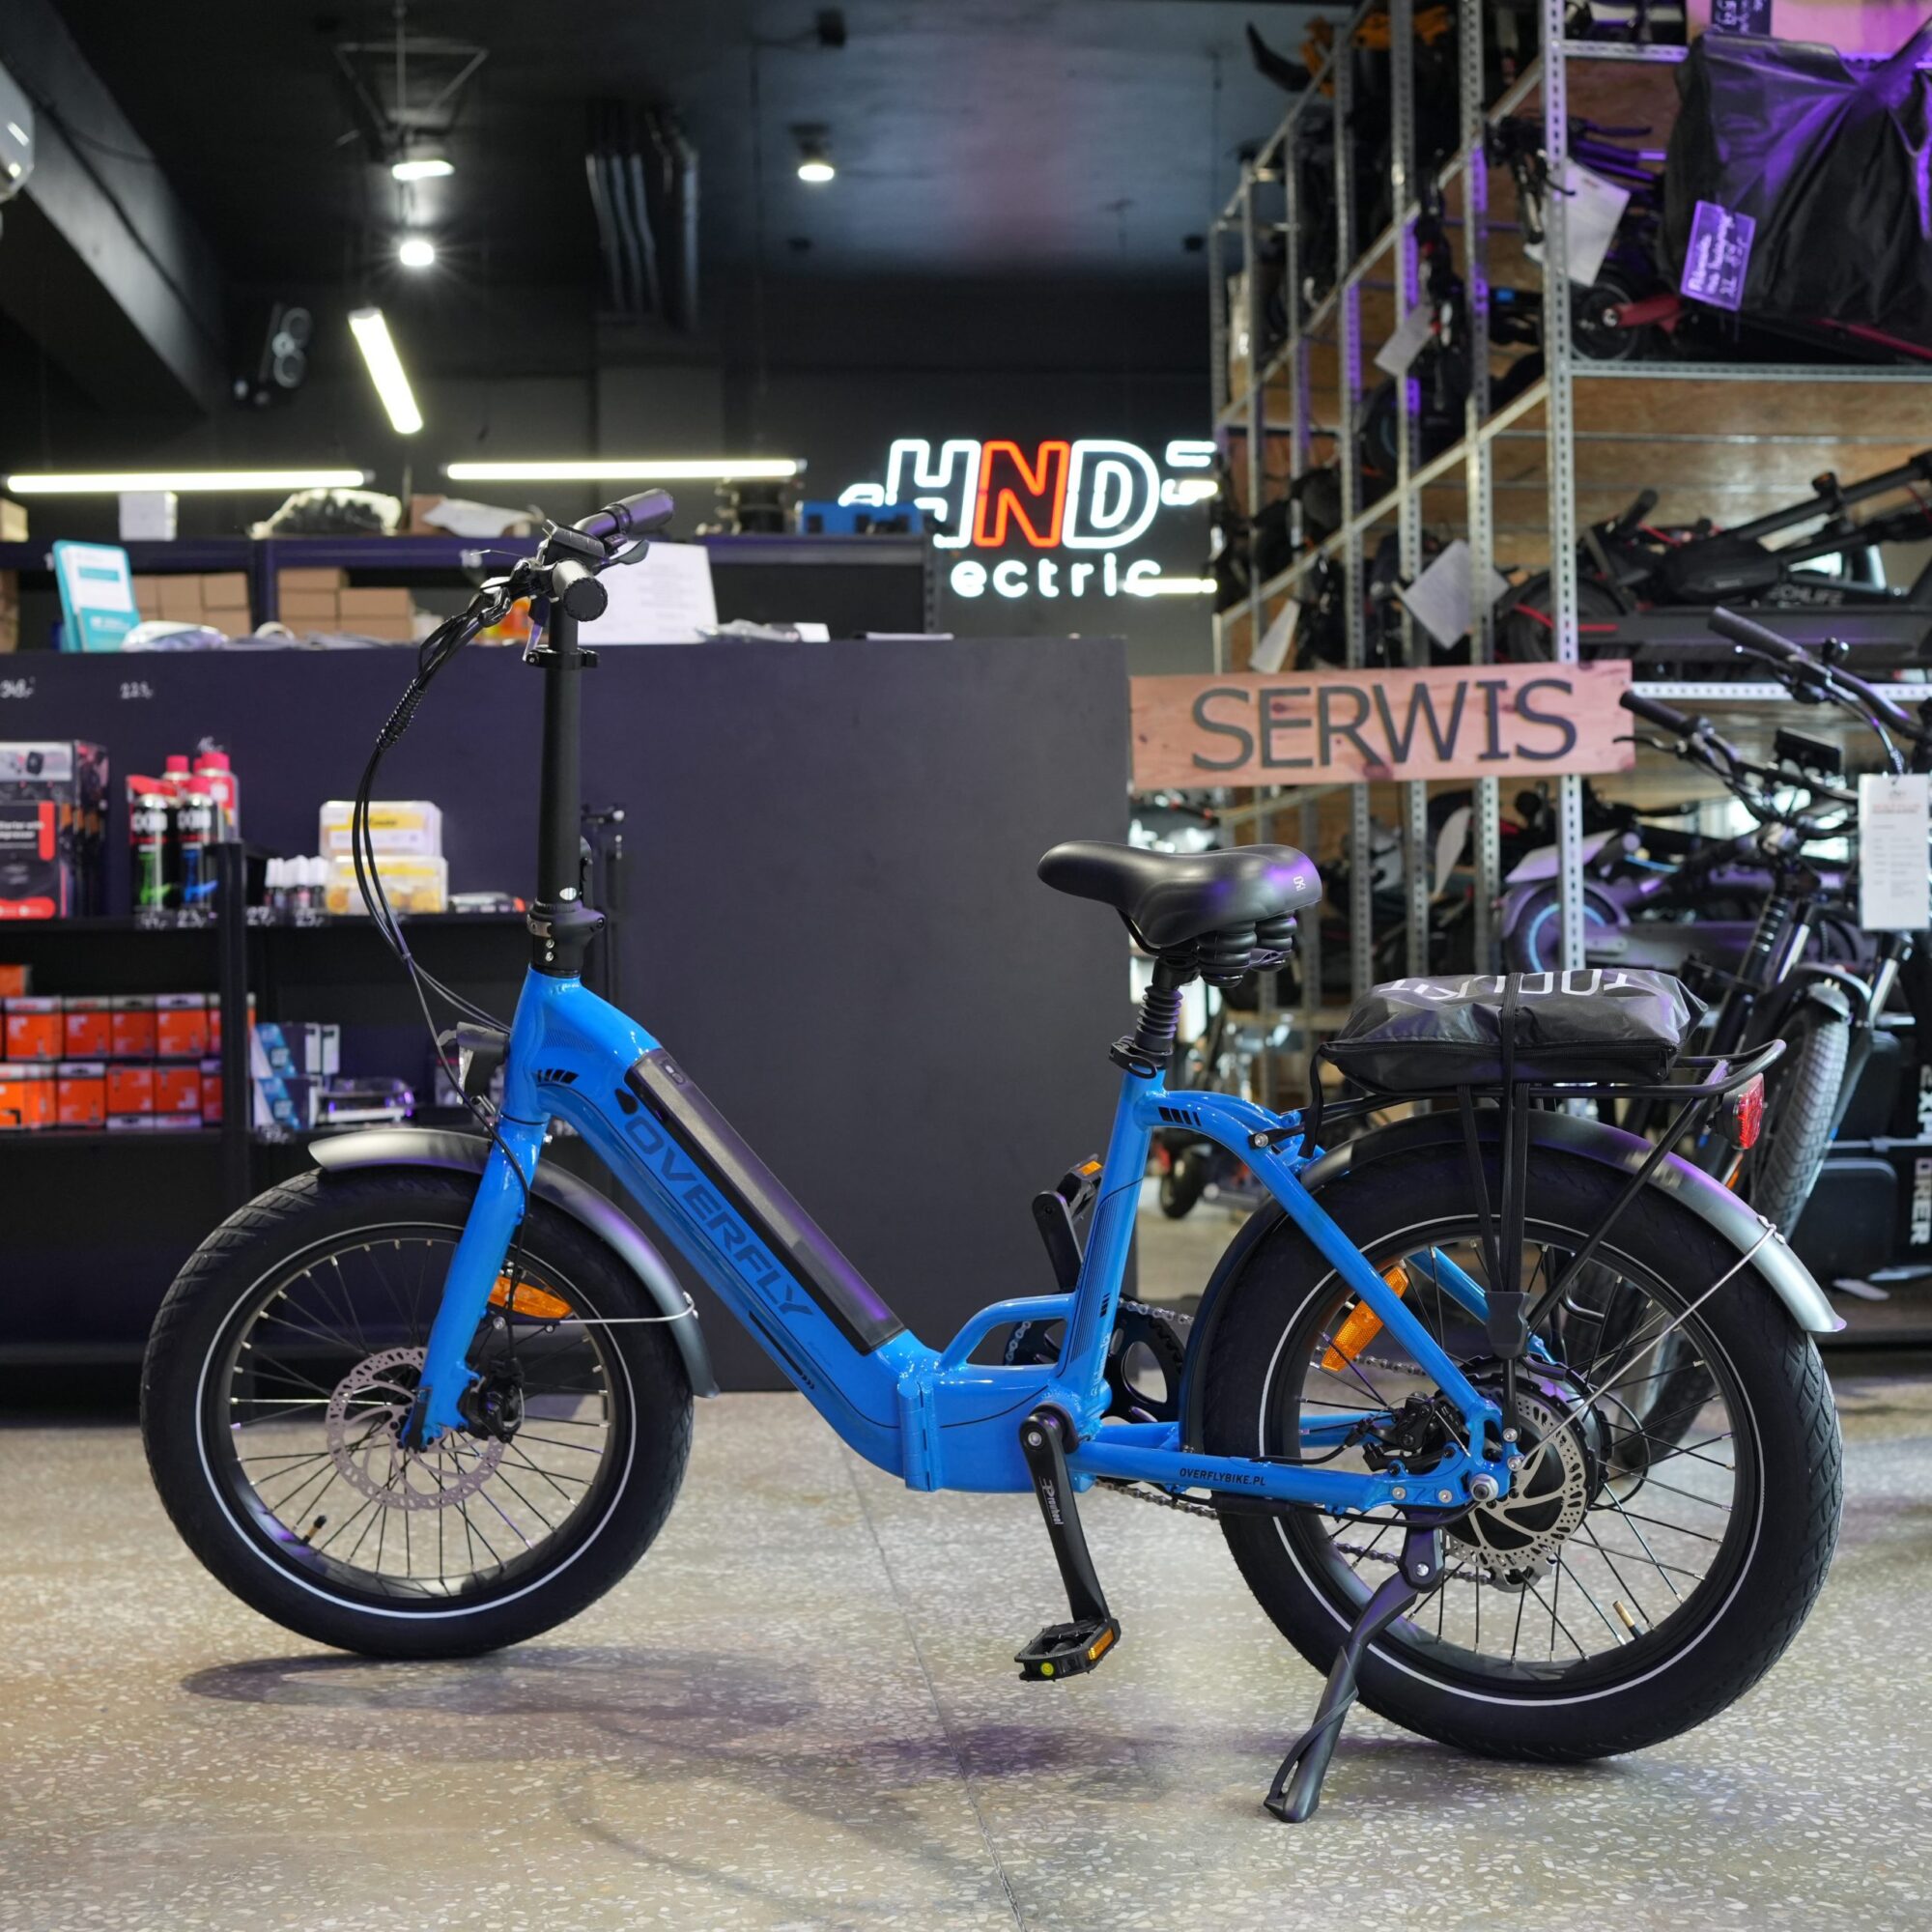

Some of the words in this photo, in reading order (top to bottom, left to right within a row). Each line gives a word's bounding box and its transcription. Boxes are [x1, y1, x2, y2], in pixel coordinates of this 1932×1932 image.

[885, 439, 1162, 550] HND
[950, 553, 1162, 599] ectric
[1191, 678, 1578, 772] SERWIS
[624, 1115, 814, 1317] OVERFLY
[1179, 1467, 1266, 1487] OVERFLYBIKE.PL
